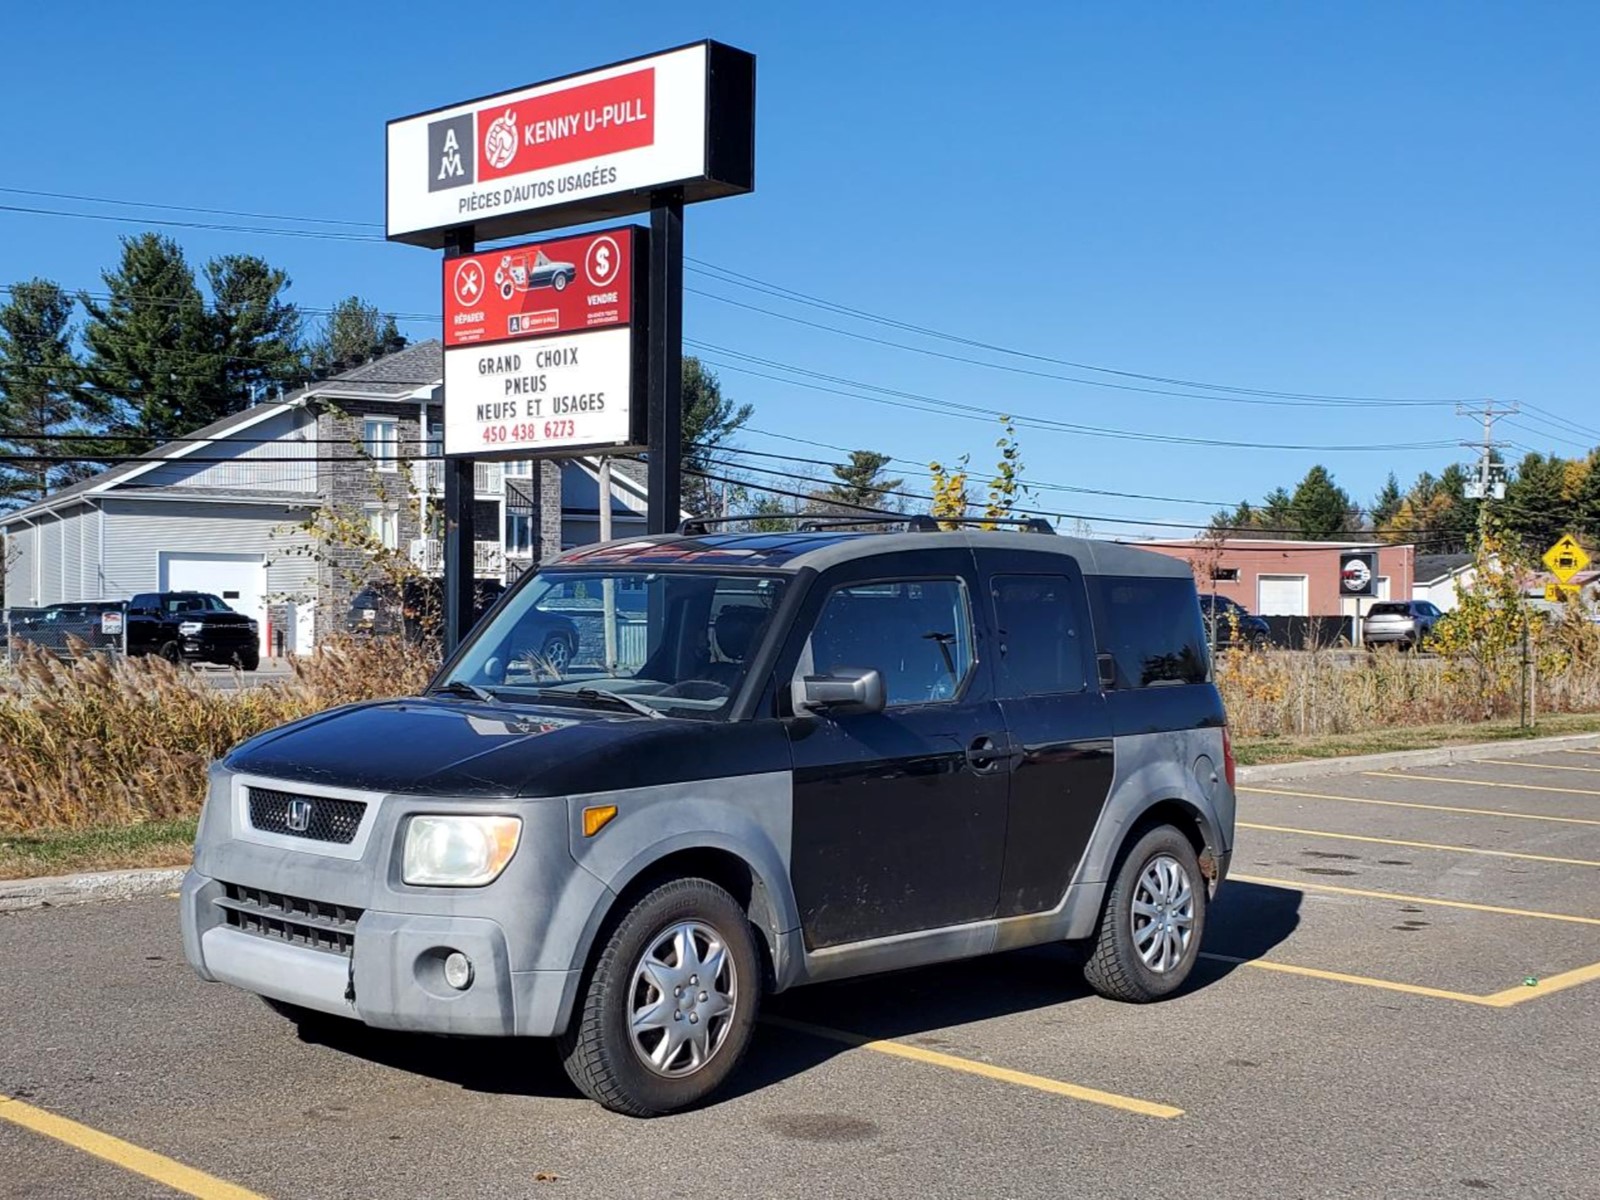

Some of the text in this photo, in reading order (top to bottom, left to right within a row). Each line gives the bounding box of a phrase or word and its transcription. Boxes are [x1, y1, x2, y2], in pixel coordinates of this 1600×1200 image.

[524, 98, 647, 146] KENNY U-PULL
[458, 166, 617, 214] PIÈCES D'AUTOS USAGÉES
[587, 291, 618, 306] VENDRE
[478, 347, 578, 374] GRAND CHOIX
[505, 375, 547, 395] PNEUS
[477, 392, 605, 421] NEUFS ET USAGES
[482, 420, 575, 442] 450 438 6273
